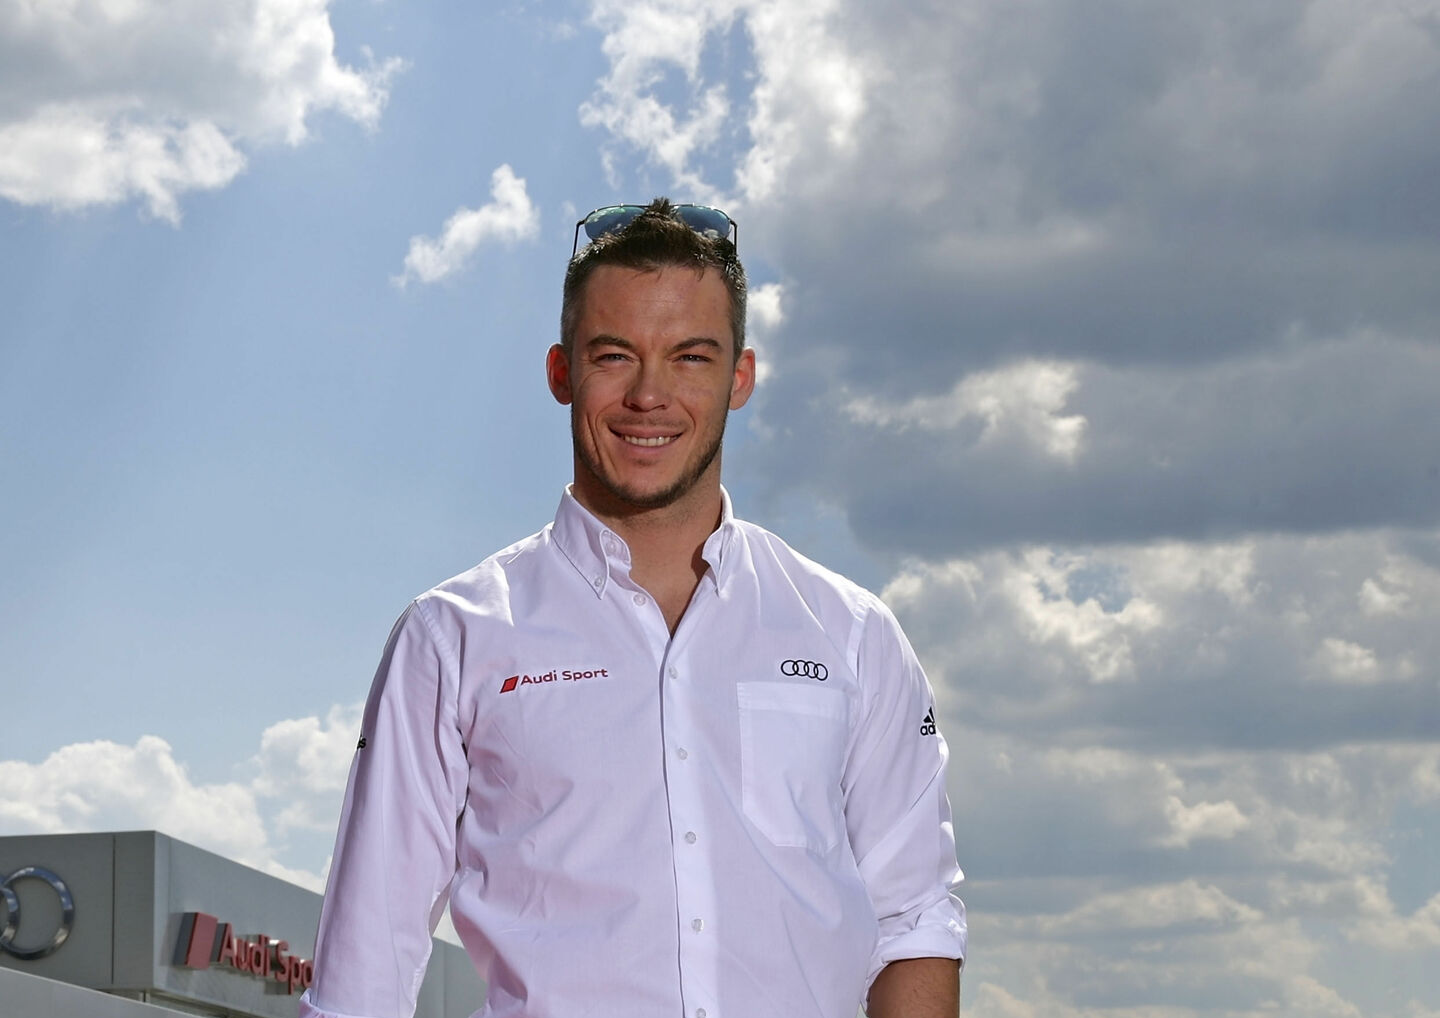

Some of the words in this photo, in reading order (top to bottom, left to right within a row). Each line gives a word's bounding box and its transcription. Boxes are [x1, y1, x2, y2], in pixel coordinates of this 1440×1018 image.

[520, 670, 558, 685] Audi
[562, 668, 609, 681] Sport
[217, 922, 270, 977] Audi
